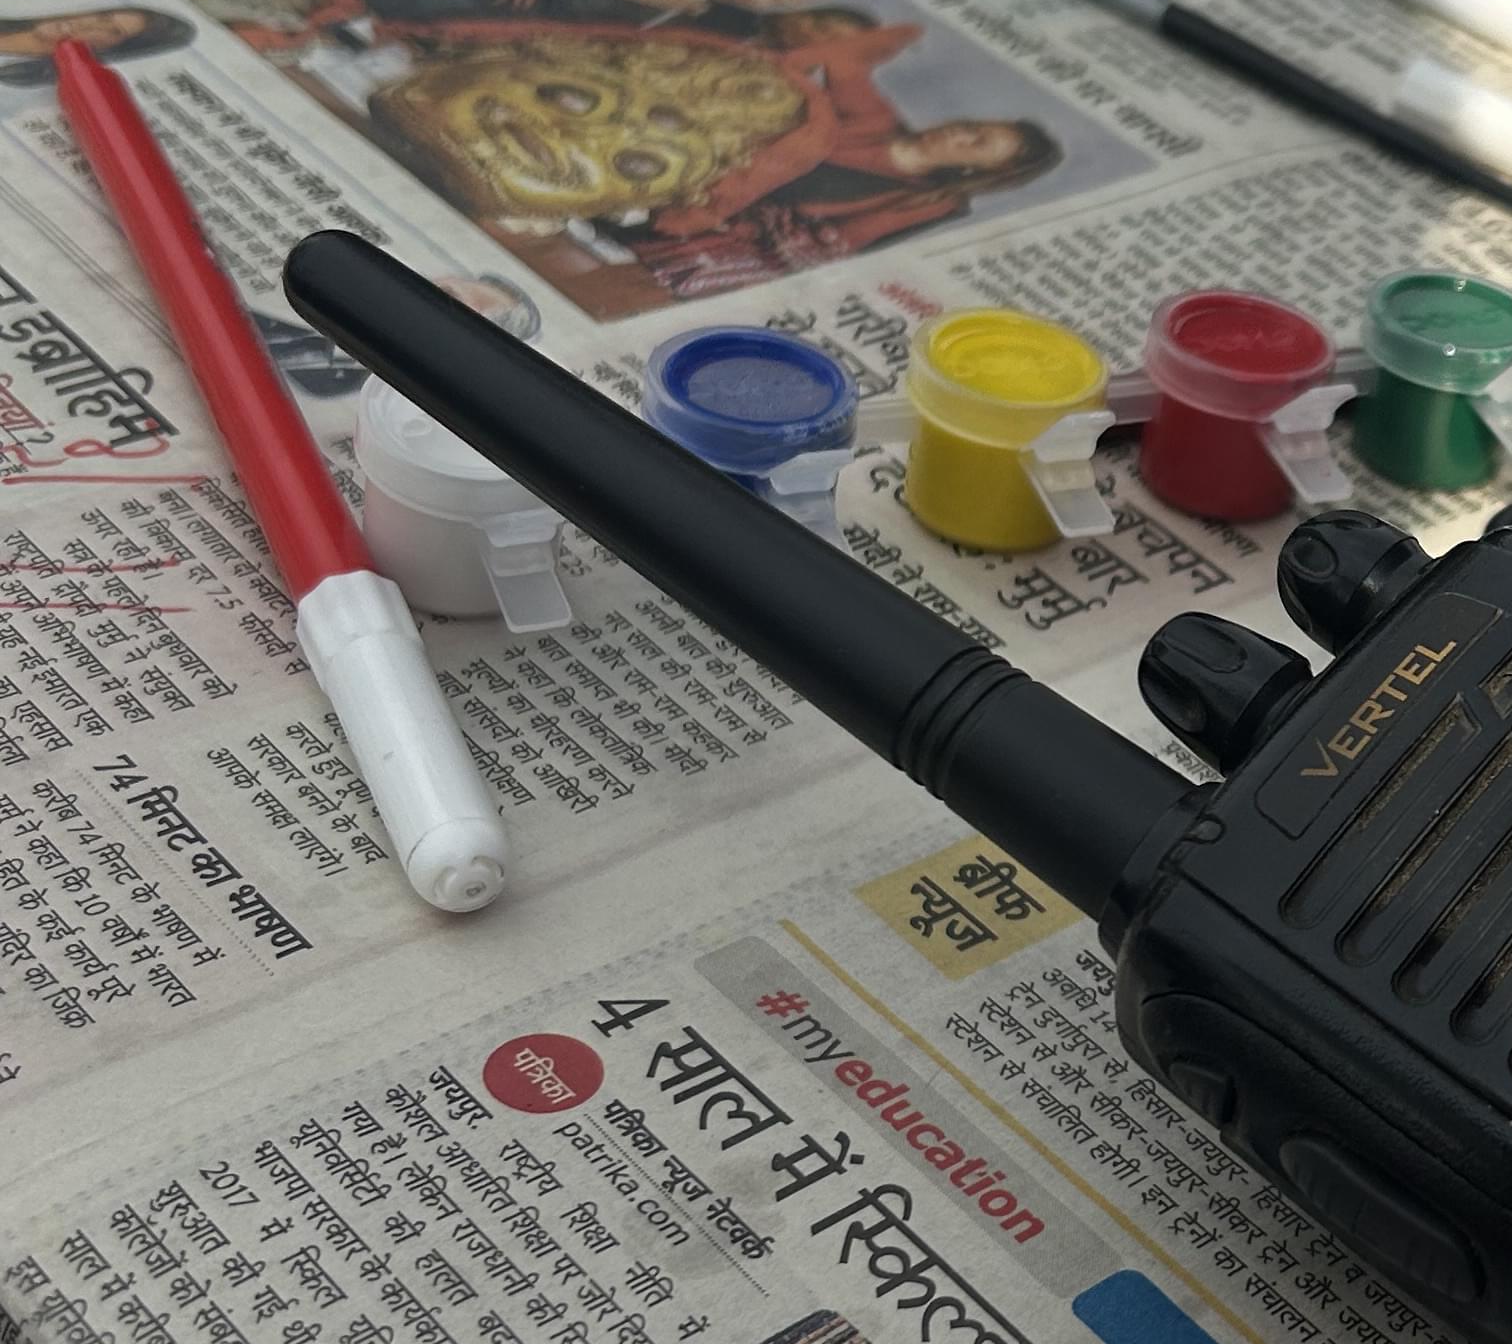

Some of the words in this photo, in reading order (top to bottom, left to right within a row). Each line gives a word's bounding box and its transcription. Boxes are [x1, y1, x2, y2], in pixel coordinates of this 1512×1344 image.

[0, 309, 181, 449] इब्राहिम
[1071, 537, 1151, 597] बार
[206, 747, 262, 789] आपके
[251, 788, 301, 830] समक्ष
[1300, 640, 1457, 777] VERTEL
[32, 778, 83, 822] करीब
[66, 820, 103, 845] 74
[88, 842, 143, 885] मिनट
[130, 881, 161, 903] के
[151, 904, 203, 950] भाषण
[193, 946, 226, 967] में
[92, 754, 149, 793] 74
[126, 785, 209, 852] मिनट
[191, 847, 243, 888] का
[228, 884, 314, 960] भाषण
[247, 733, 307, 784] सरकार
[298, 782, 343, 816] बनने
[331, 813, 360, 833] के
[350, 832, 390, 865] बाद
[909, 875, 999, 952] न्यूज
[952, 854, 1046, 921] ब्रीफ
[513, 1047, 577, 1105] पत्रिका
[591, 999, 670, 1038] 4
[646, 1026, 793, 1151] साल
[770, 1131, 865, 1202] में
[755, 990, 1045, 1244] #myeducation
[289, 1118, 392, 1207] यूनिवर्सिटी
[384, 1210, 427, 1245] की
[415, 1248, 479, 1307] हालत
[341, 1100, 384, 1138] गया
[370, 1132, 408, 1165] है।
[396, 1161, 463, 1221] लेकिन
[451, 1217, 540, 1297] राजधानी
[526, 1292, 568, 1328] की
[385, 1083, 450, 1143] कौशल
[436, 1141, 518, 1214] आधारित
[501, 1205, 562, 1259] शिक्षा
[552, 1253, 588, 1286] पर
[577, 1278, 623, 1323] जोर
[429, 1065, 494, 1130] जयपुर.
[498, 1138, 564, 1197] राष्ट्रीय
[559, 1201, 621, 1255] शिक्षा
[625, 1261, 673, 1308] नीति
[678, 1315, 711, 1341] में
[552, 1121, 690, 1247] patrika.com
[603, 1098, 668, 1158] पत्रिका
[661, 1154, 713, 1203] न्यूज
[706, 1197, 775, 1260] नेटवर्क
[945, 1012, 1005, 1063] स्टेशन
[999, 1059, 1026, 1081] से
[1021, 1077, 1099, 1145] संचालित
[1089, 1140, 1149, 1188] होगी।
[1141, 1183, 1180, 1215] इन
[1168, 1211, 1224, 1249] ट्रेनों
[1213, 1246, 1249, 1277] का
[1245, 1272, 1322, 1343] संचालन
